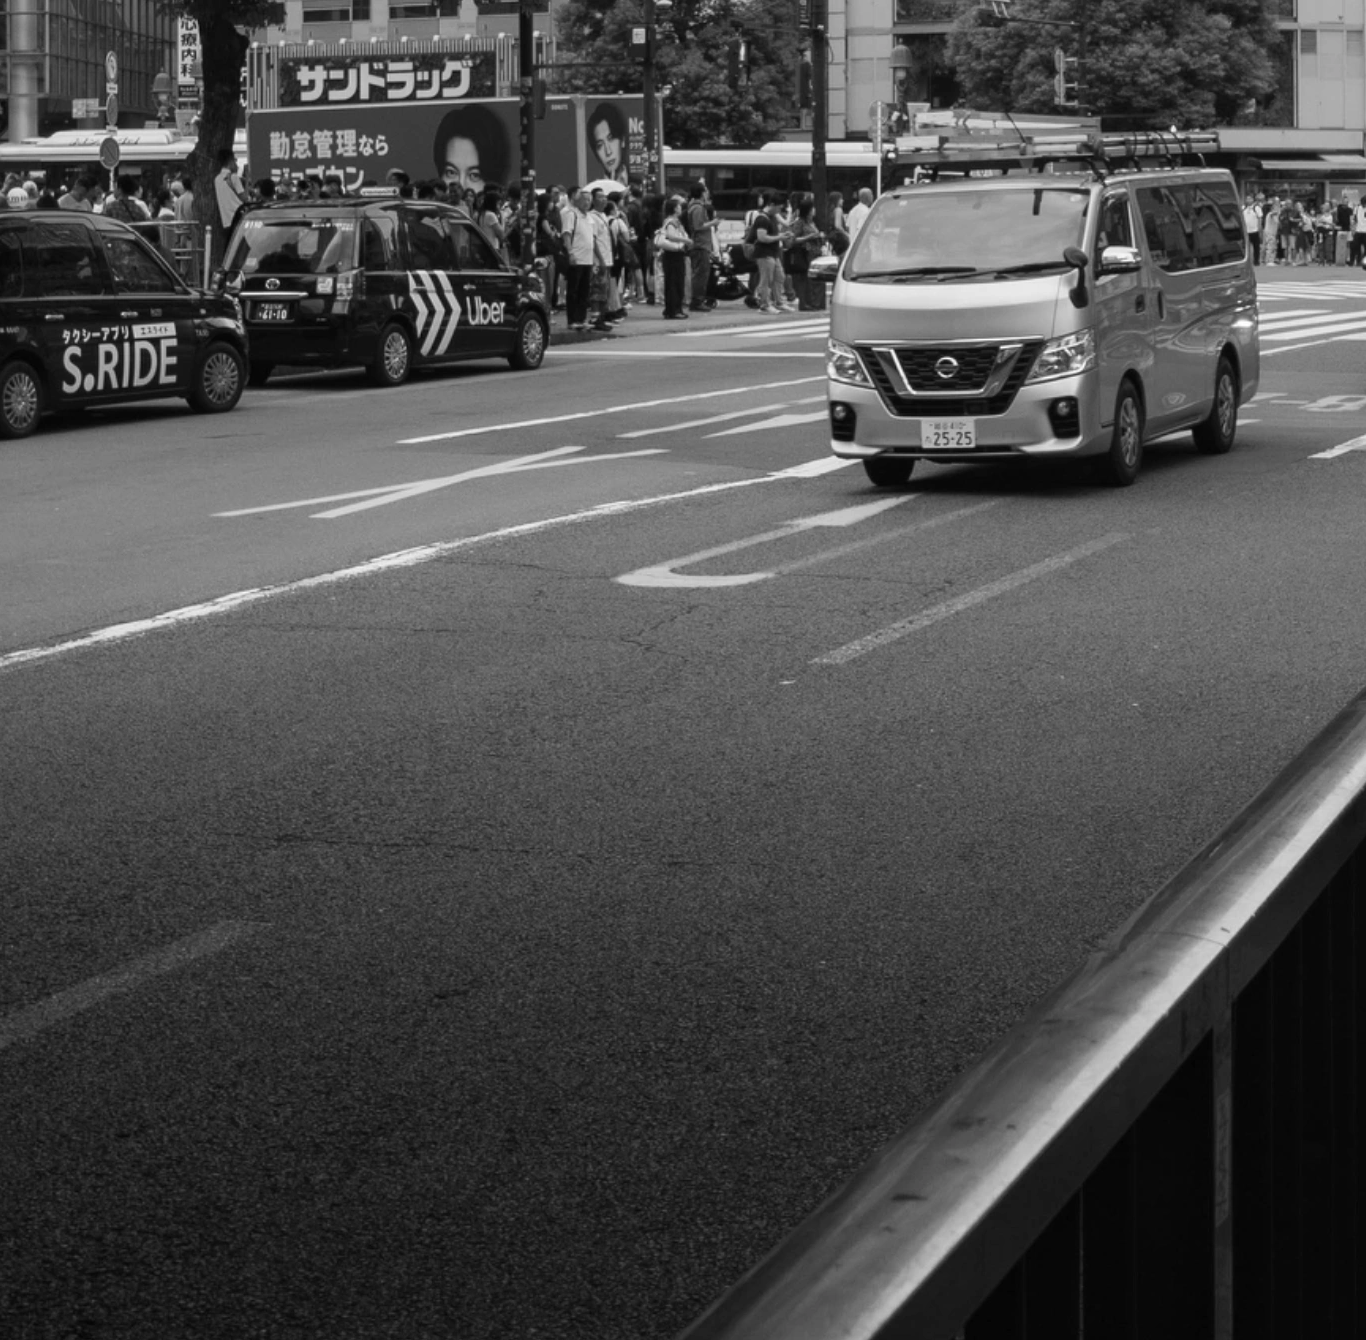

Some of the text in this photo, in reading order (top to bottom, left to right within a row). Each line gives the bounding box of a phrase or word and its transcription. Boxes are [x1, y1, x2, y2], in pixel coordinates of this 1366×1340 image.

[296, 60, 474, 101] サンドラッグ
[269, 128, 389, 160] 勤怠管理なら
[466, 296, 506, 325] Uber
[62, 325, 170, 345] タクシーアプリ エスライド
[62, 338, 177, 394] S.RIDE
[933, 431, 973, 447] 25-25
